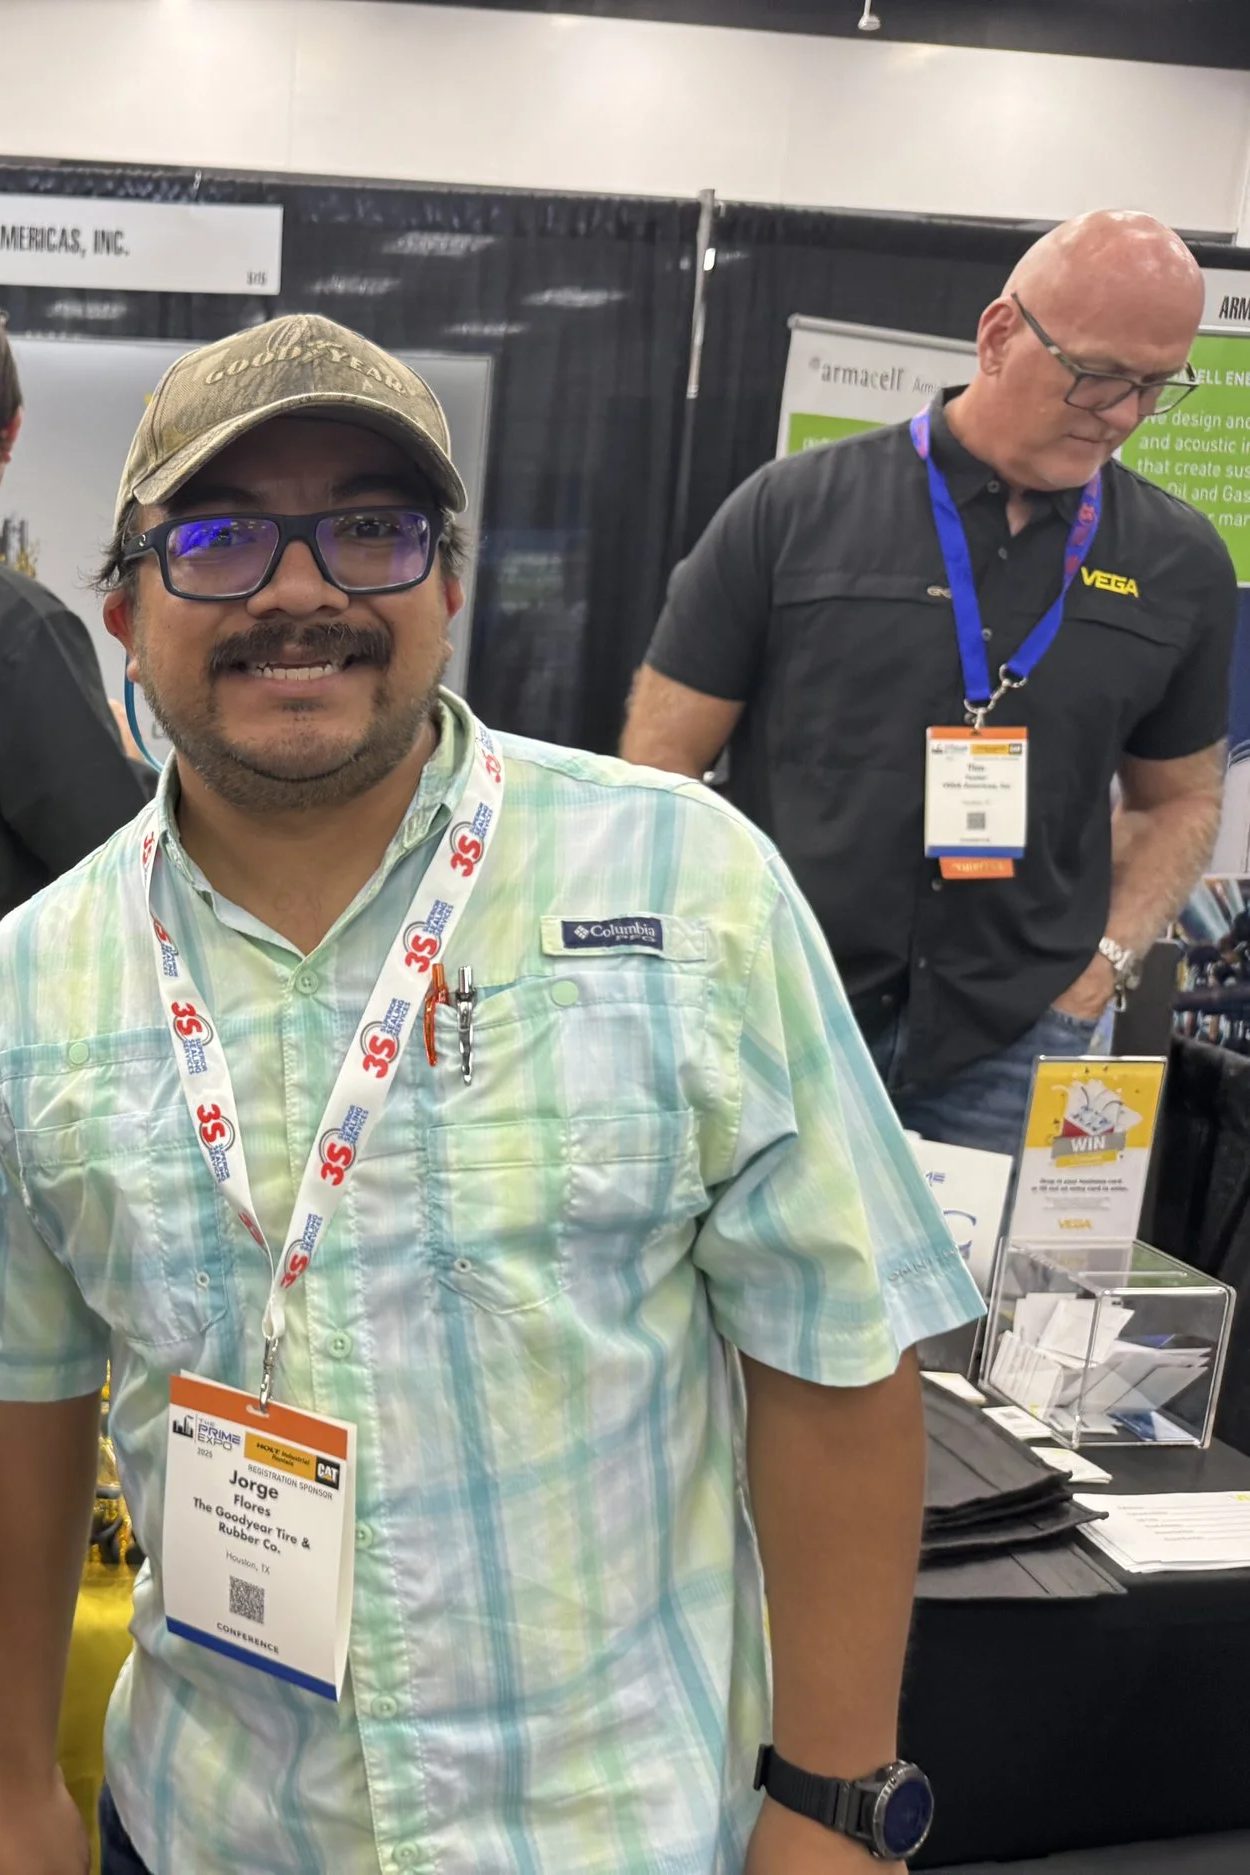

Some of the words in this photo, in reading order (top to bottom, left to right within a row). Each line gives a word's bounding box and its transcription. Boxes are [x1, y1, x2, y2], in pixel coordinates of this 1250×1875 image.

[93, 228, 129, 256] INC.
[822, 362, 902, 391] armacell
[1172, 409, 1221, 432] design
[1139, 433, 1170, 450] and
[1175, 436, 1236, 454] acoustic
[1137, 458, 1169, 474] that
[1175, 462, 1221, 477] create
[1192, 484, 1217, 502] and
[1081, 566, 1139, 598] VEGA
[451, 834, 481, 877] 3S
[590, 922, 656, 937] Columbia
[405, 934, 437, 973] 3S
[171, 1002, 203, 1036] 3S
[363, 1035, 395, 1079] 3S
[197, 1104, 225, 1142] 3S
[1071, 1136, 1106, 1153] WIN
[321, 1142, 352, 1186] 3S
[197, 1434, 233, 1451] EXPO
[198, 1424, 241, 1446] PRIME
[256, 1442, 280, 1454] HOLT
[281, 1449, 311, 1466] Industrial
[229, 1470, 279, 1500] Jorge
[247, 1464, 298, 1488] REGISTRATION
[299, 1482, 333, 1501] SPONSOR
[317, 1462, 338, 1483] CAT
[234, 1494, 271, 1517] Flores
[193, 1497, 213, 1513] The
[215, 1505, 273, 1535] Goodyear
[276, 1527, 298, 1545] Tire
[301, 1537, 311, 1550] &
[218, 1521, 260, 1545] Rubber
[263, 1538, 281, 1554] Co.
[226, 1550, 258, 1572] Houston,
[261, 1563, 271, 1575] TX
[216, 1622, 279, 1654] CONFERENCE
